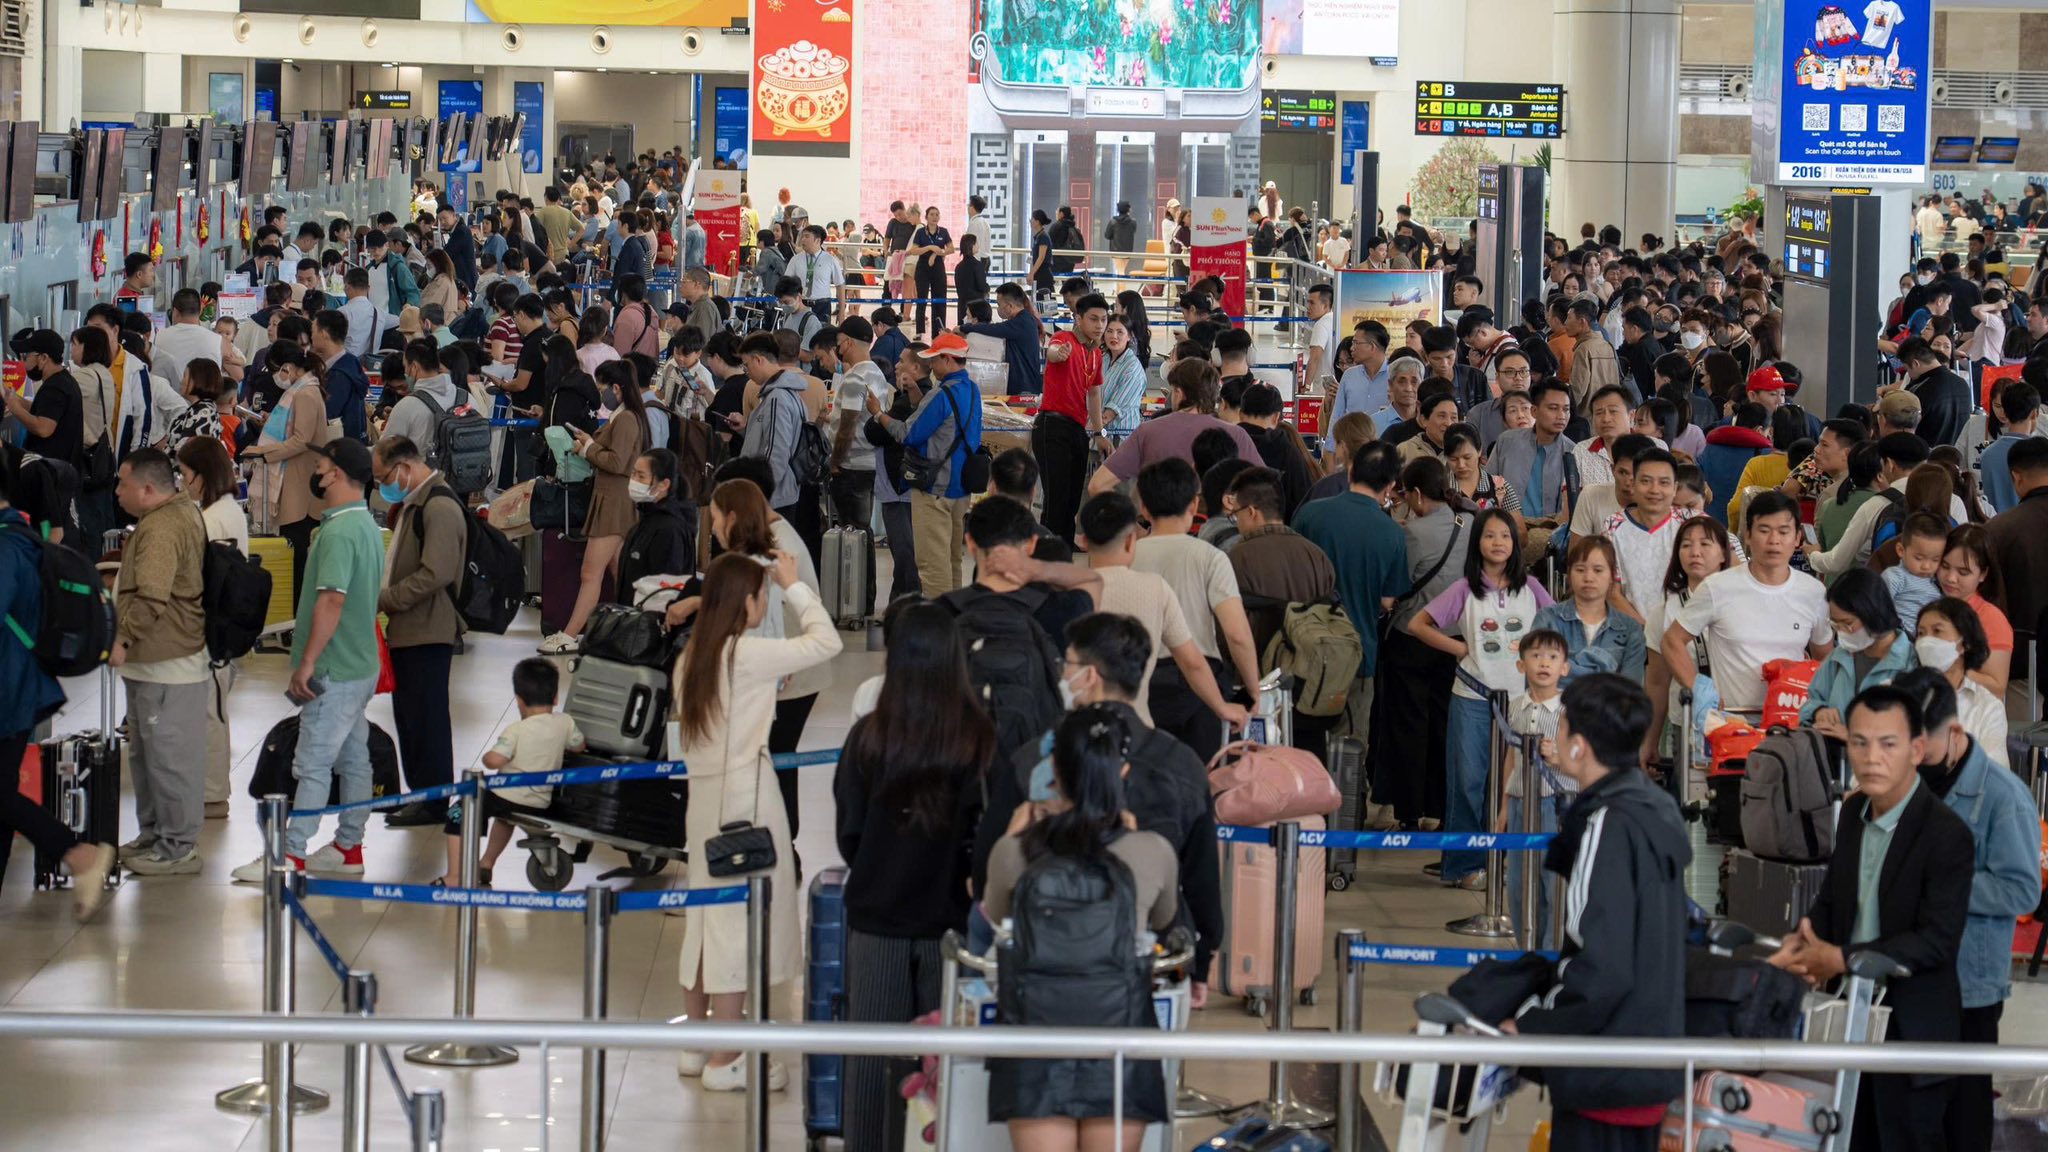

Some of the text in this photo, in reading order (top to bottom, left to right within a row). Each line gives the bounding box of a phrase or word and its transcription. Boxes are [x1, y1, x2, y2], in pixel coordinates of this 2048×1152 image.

[1444, 83, 1455, 96] B
[1521, 93, 1548, 101] Departure
[1487, 103, 1514, 118] A,B
[1819, 140, 1836, 148] Quét
[1791, 165, 1822, 178] 2016
[1933, 174, 1956, 190] B03
[1197, 255, 1241, 265] PHỔ THÔNG
[601, 767, 619, 778] ACV
[655, 762, 673, 773] ACV
[488, 775, 508, 787] ACV
[546, 773, 564, 785] ACV
[1216, 827, 1235, 839] CV
[1298, 832, 1326, 846] ACV
[1381, 834, 1412, 847] ACV
[1467, 835, 1497, 848] ACV
[372, 885, 404, 898] N.I.A
[432, 888, 469, 902] CẢNG
[470, 890, 507, 905] HÀNG
[509, 892, 554, 907] KHÔNG
[658, 892, 690, 906] ACV
[1382, 948, 1438, 962] AIRPORT
